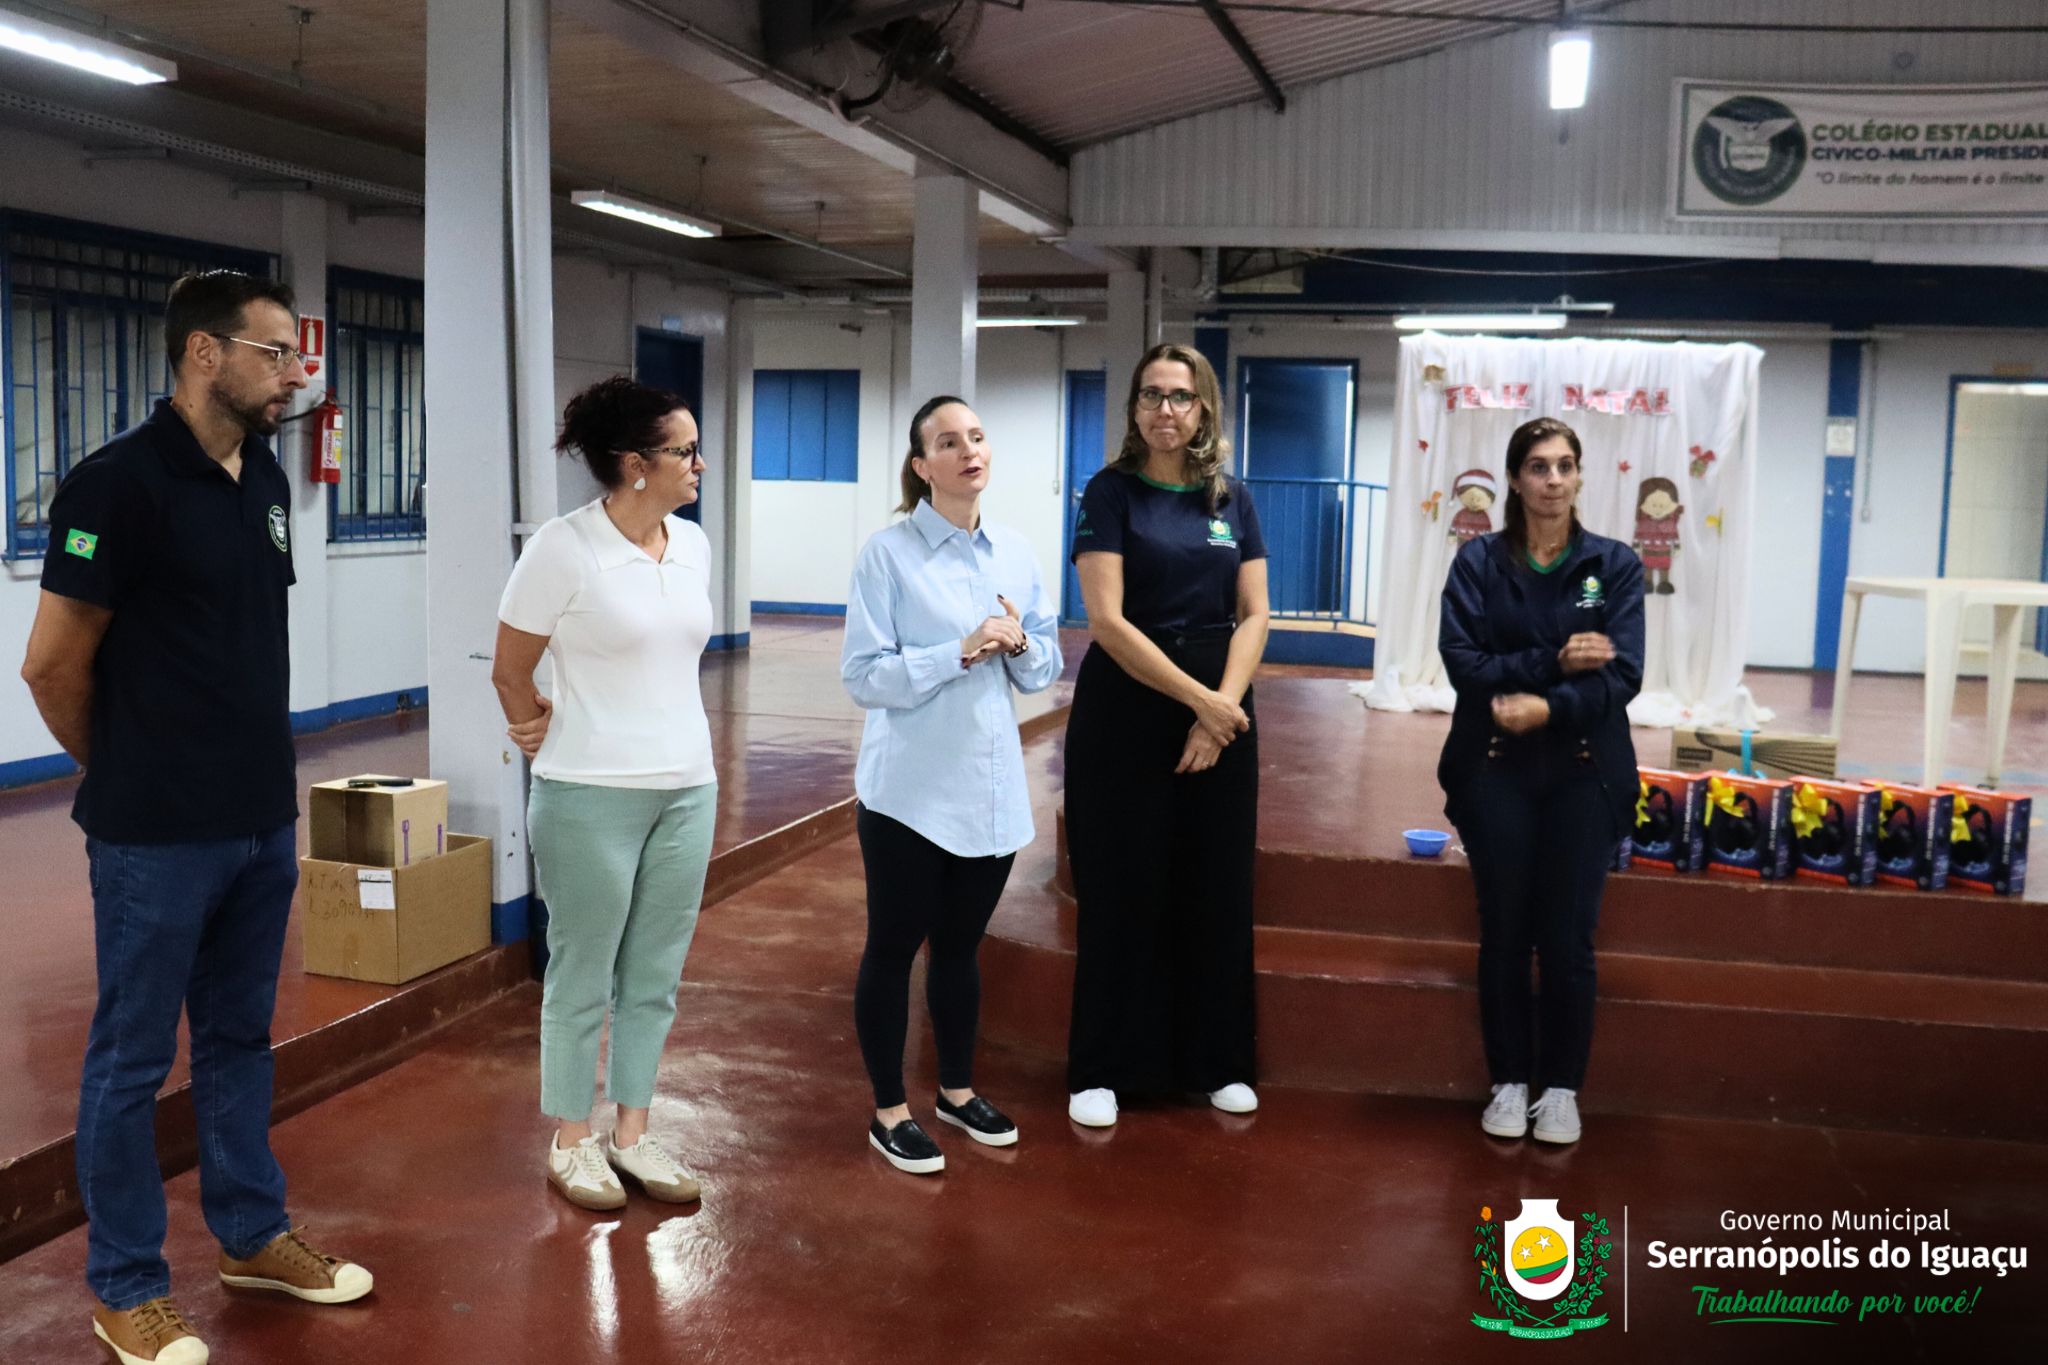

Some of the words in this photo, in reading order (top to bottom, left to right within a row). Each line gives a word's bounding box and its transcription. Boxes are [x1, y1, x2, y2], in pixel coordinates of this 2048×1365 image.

[1812, 119, 1919, 141] COLÉGIO
[1925, 123, 2048, 141] ESTADUAL
[1838, 172, 1881, 184] limite
[1885, 173, 1906, 185] do
[1909, 171, 1968, 185] homem
[2000, 170, 2045, 184] limite
[1444, 383, 1532, 412] FELIZ
[1562, 384, 1672, 414] NATAL
